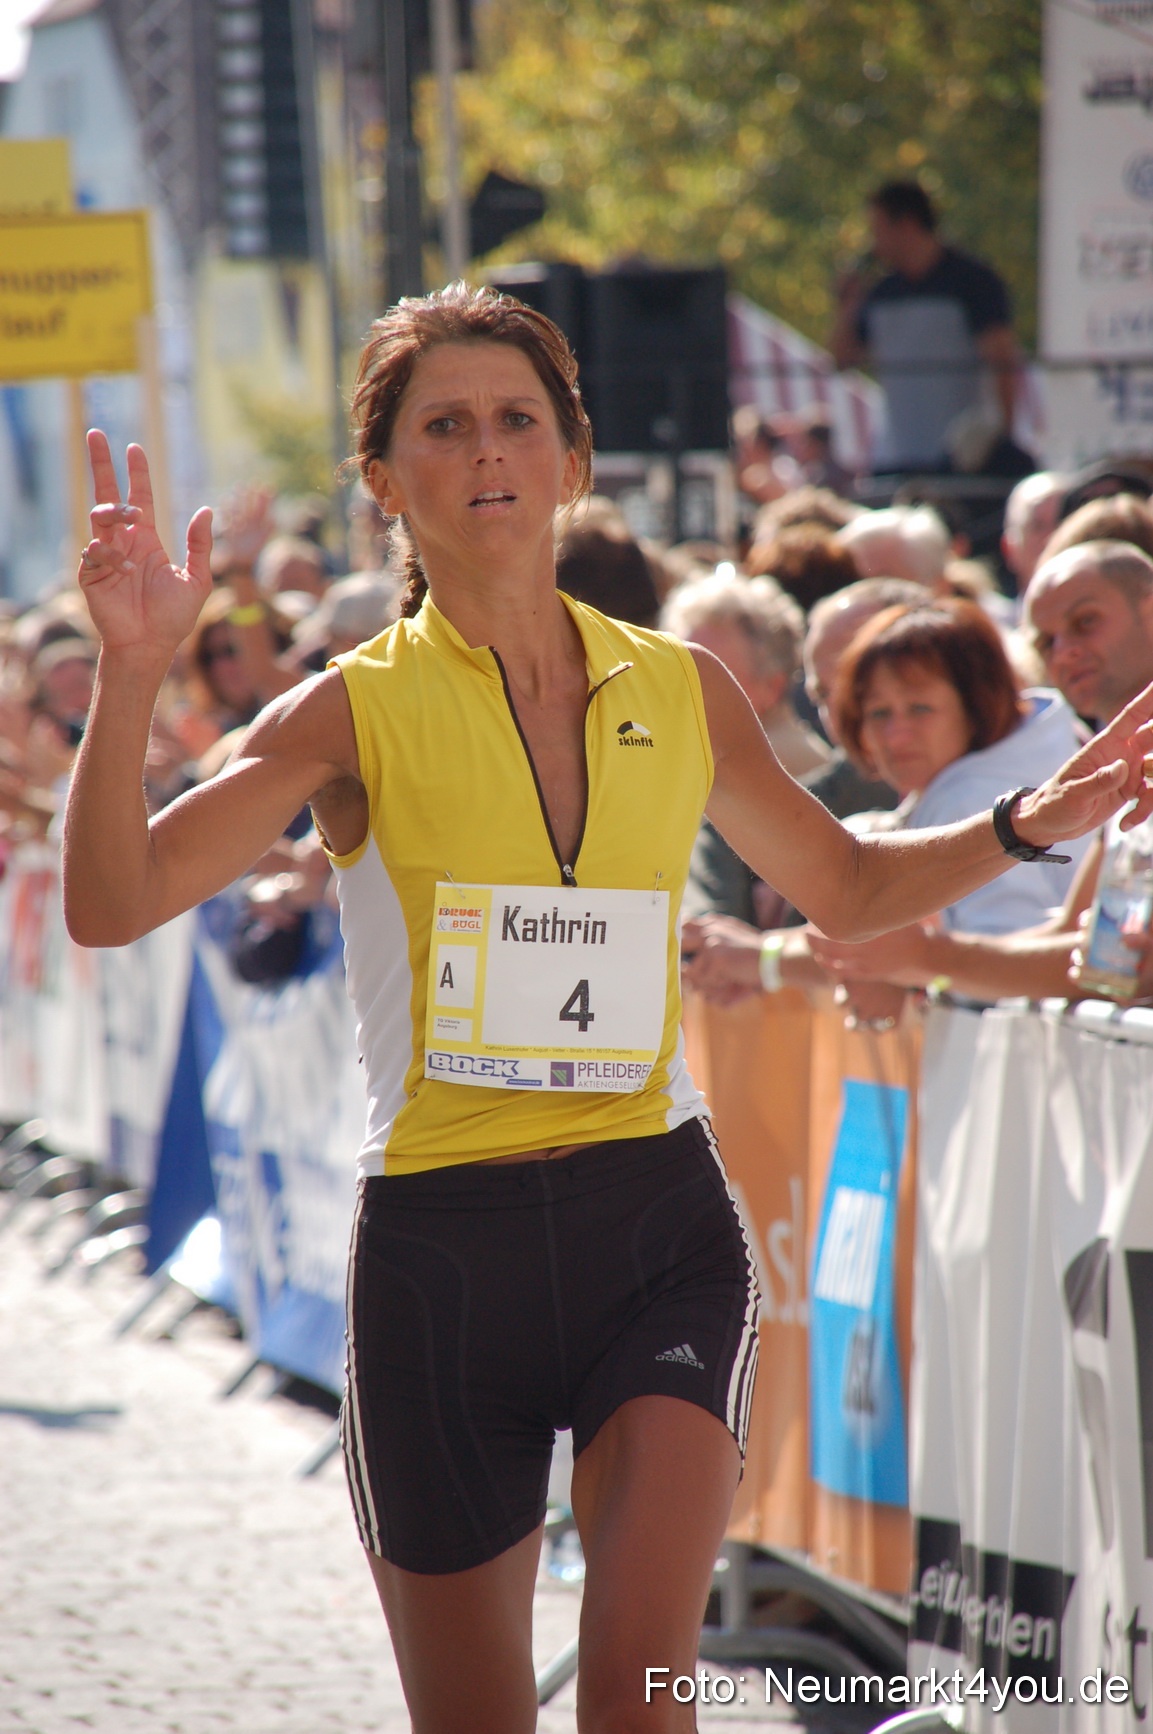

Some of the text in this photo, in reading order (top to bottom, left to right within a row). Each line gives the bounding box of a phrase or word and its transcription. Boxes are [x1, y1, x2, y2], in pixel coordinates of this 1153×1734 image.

[618, 736, 654, 747] skinfit
[501, 905, 607, 944] Kathrin
[440, 962, 454, 989] A
[559, 979, 595, 1032] 4
[429, 1053, 519, 1077] BOCK
[655, 1354, 705, 1370] adidas
